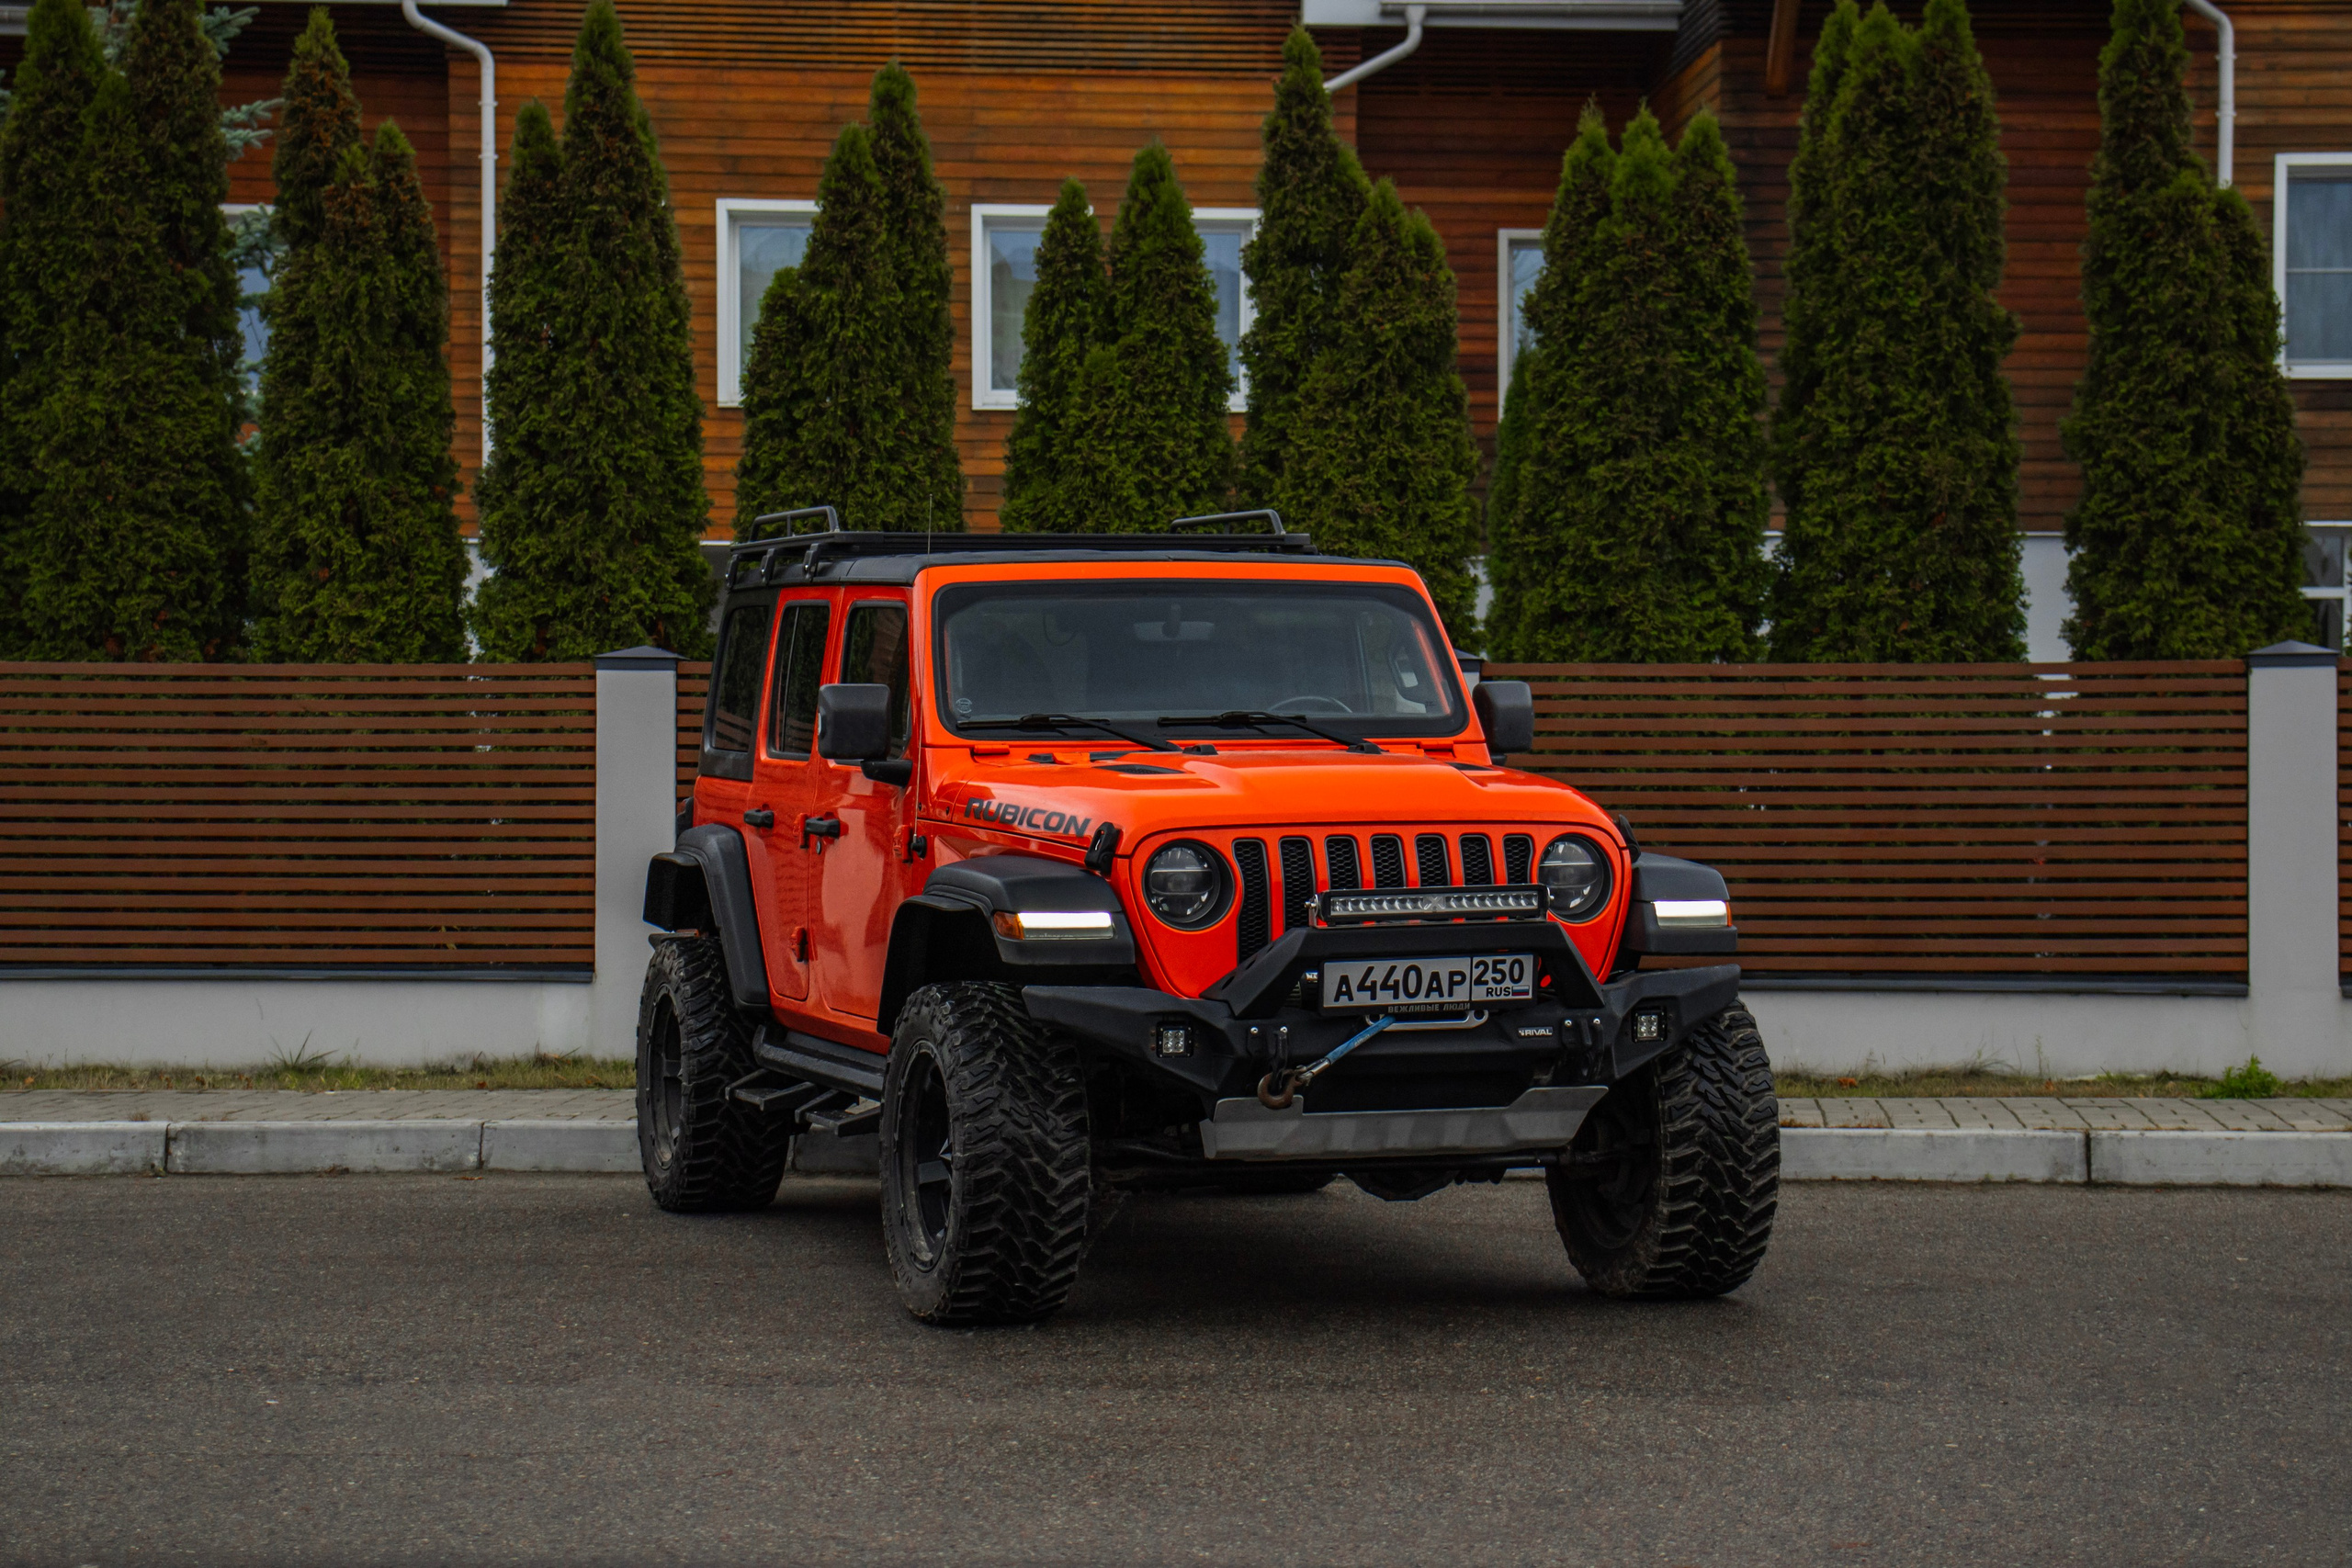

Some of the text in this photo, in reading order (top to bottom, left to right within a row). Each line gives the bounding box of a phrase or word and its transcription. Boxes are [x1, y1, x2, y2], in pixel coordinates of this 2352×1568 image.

[964, 797, 1092, 838] RUBICON
[1473, 958, 1525, 987] 250
[1486, 987, 1511, 998] RUS
[1387, 1002, 1471, 1013] ВЕЖЛИВЫЕ ЛЮДИ
